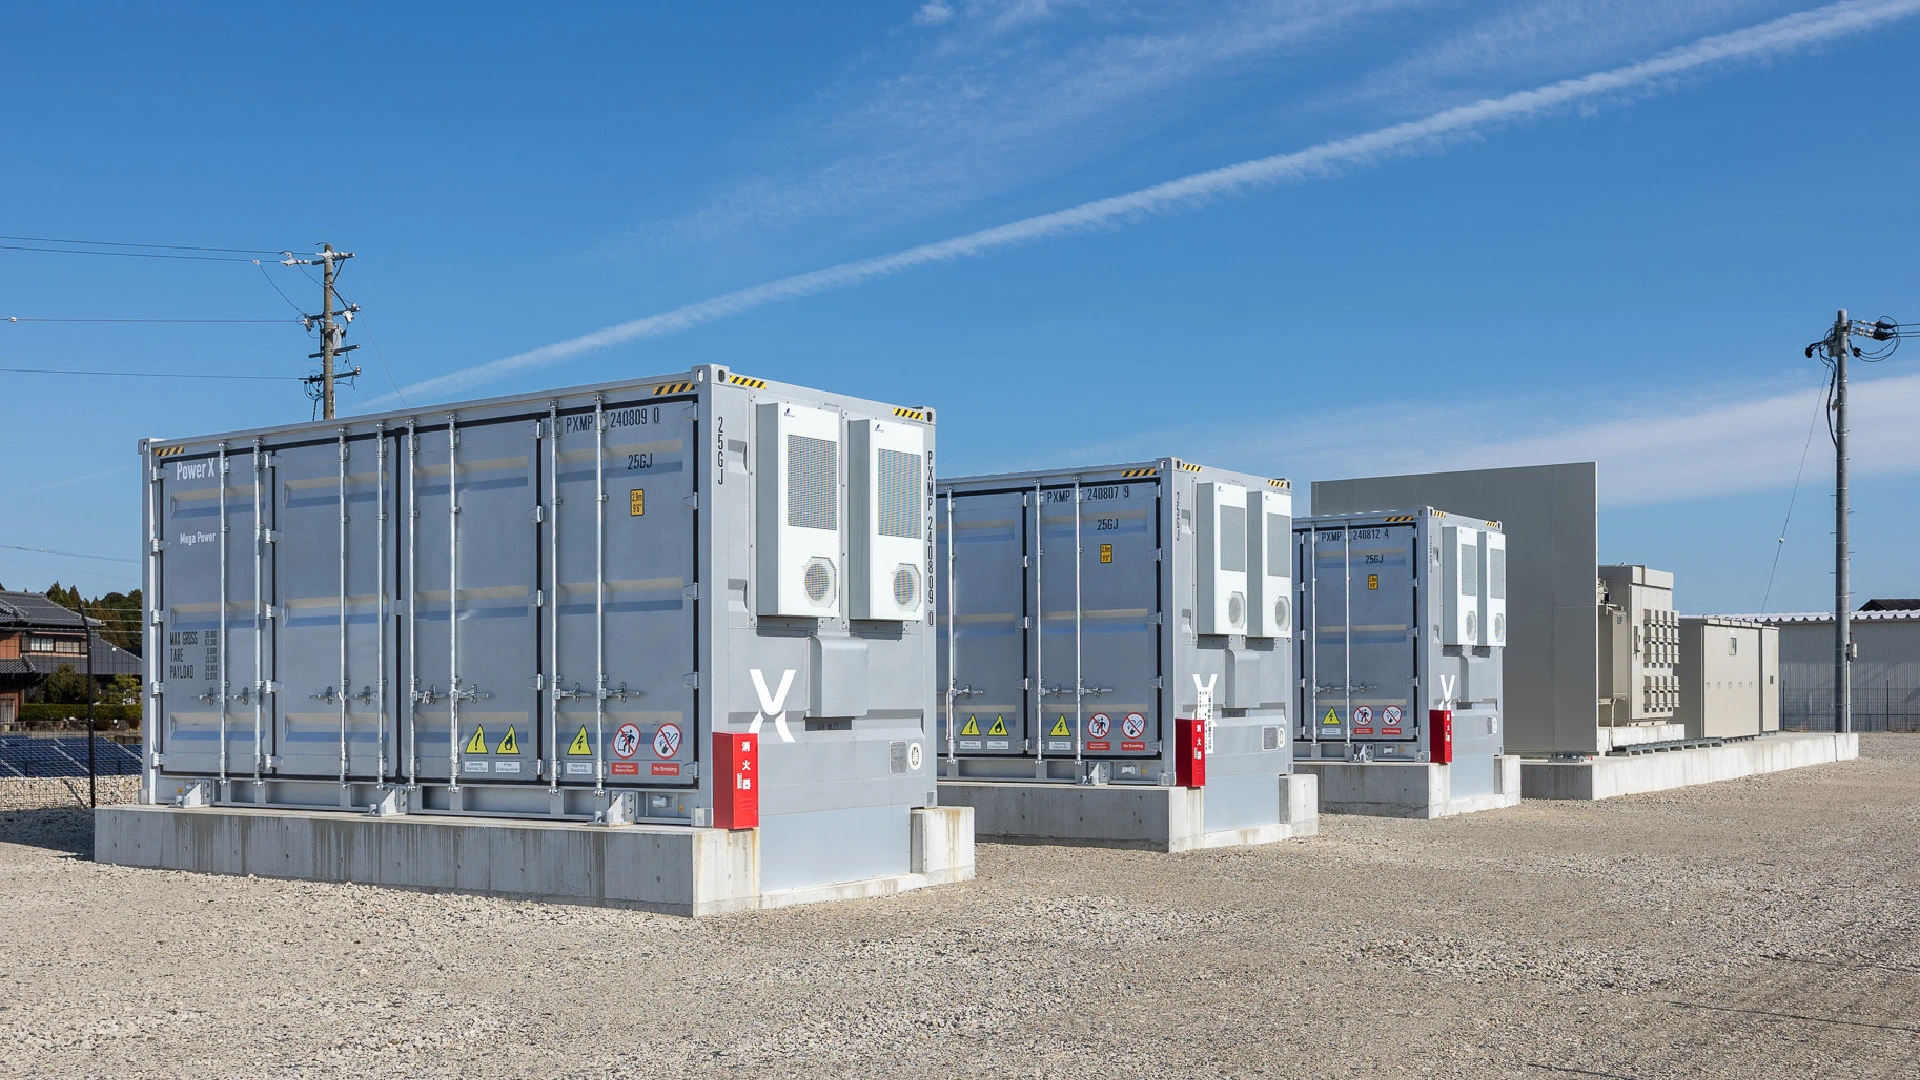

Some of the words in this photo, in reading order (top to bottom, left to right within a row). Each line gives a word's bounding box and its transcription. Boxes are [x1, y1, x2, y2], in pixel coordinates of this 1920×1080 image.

[566, 414, 593, 434] PXMP
[610, 408, 648, 428] 240809
[627, 453, 653, 470] 25GJ
[1046, 489, 1070, 504] PXMP
[1087, 486, 1119, 501] 240807
[1123, 486, 1129, 498] 9
[1097, 518, 1119, 531] 25GJ
[180, 532, 197, 546] Mega
[197, 531, 217, 544] Power
[1321, 531, 1342, 542] PXMP
[1365, 554, 1384, 565] 25GJ
